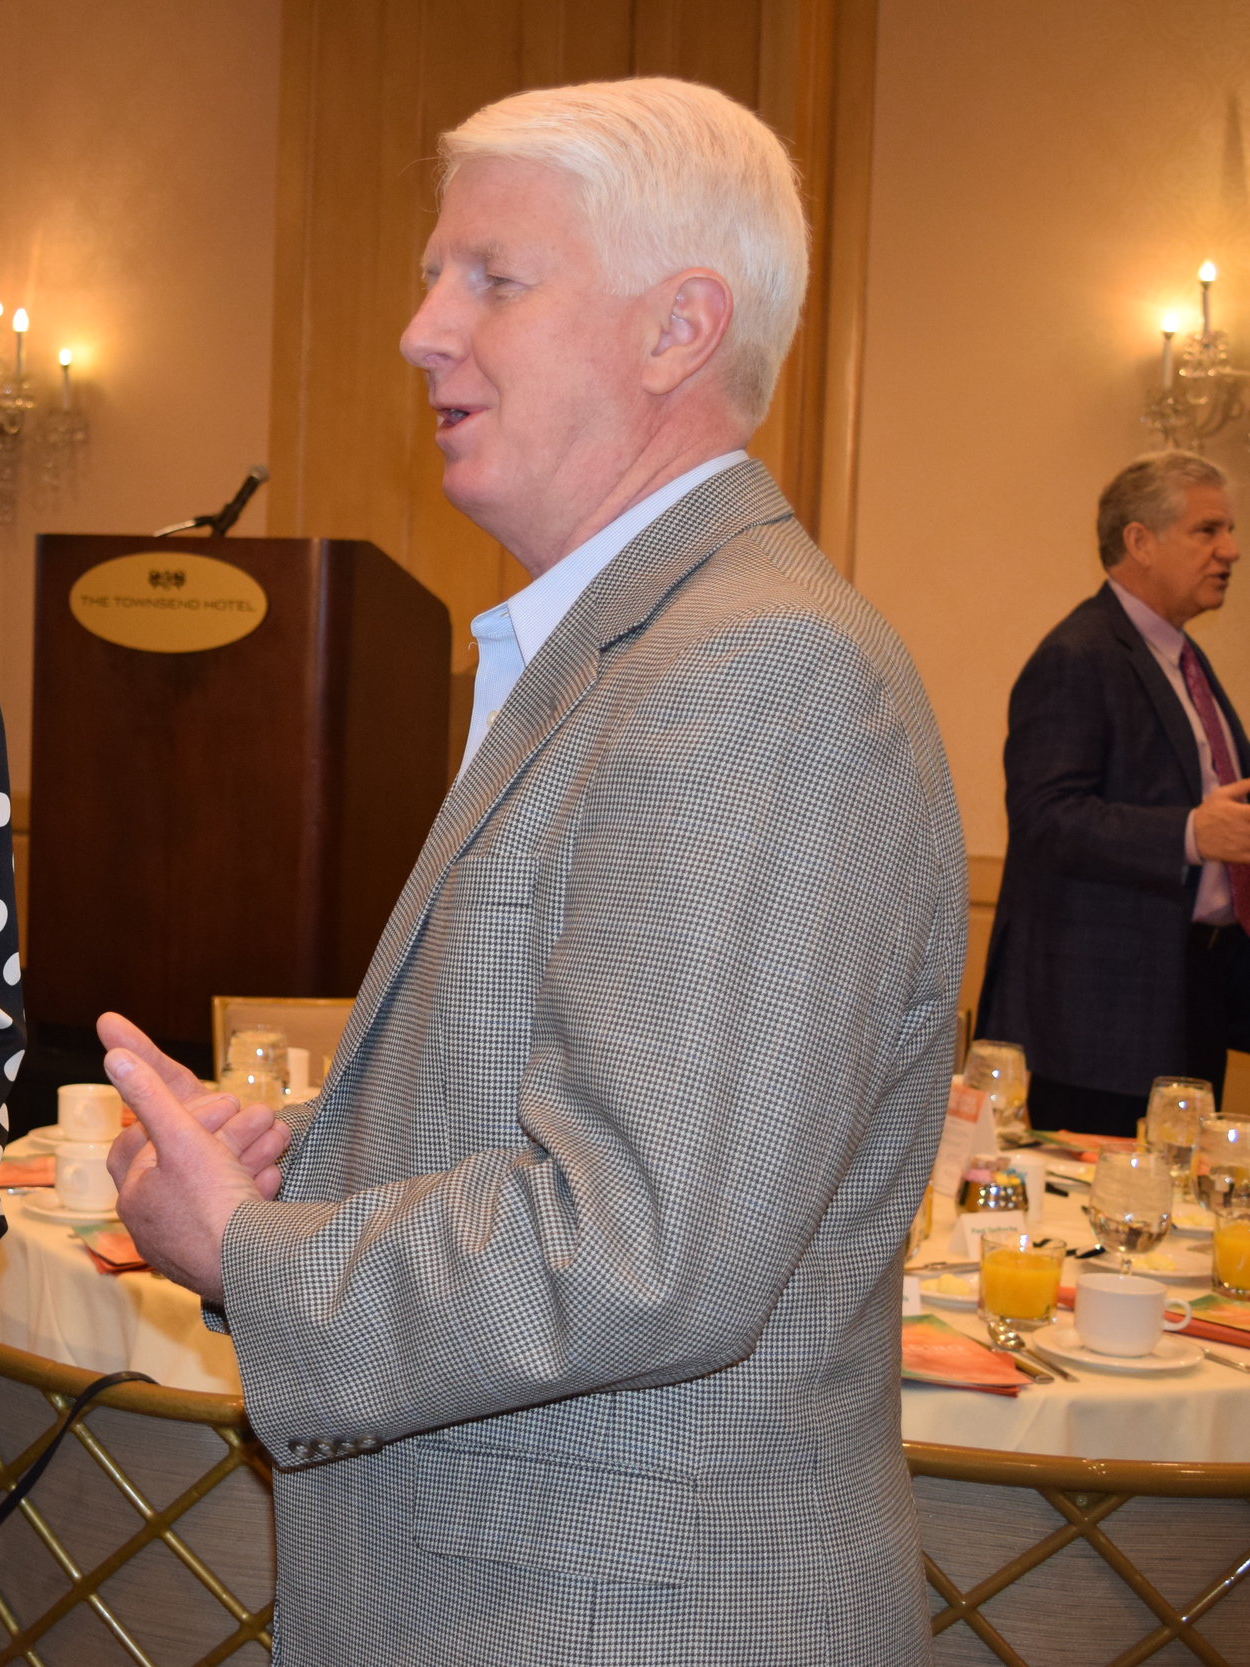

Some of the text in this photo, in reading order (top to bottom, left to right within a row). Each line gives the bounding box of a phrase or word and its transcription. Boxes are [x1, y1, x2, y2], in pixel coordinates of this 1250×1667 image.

[80, 594, 256, 612] THE TOWNSEND HOTEL
